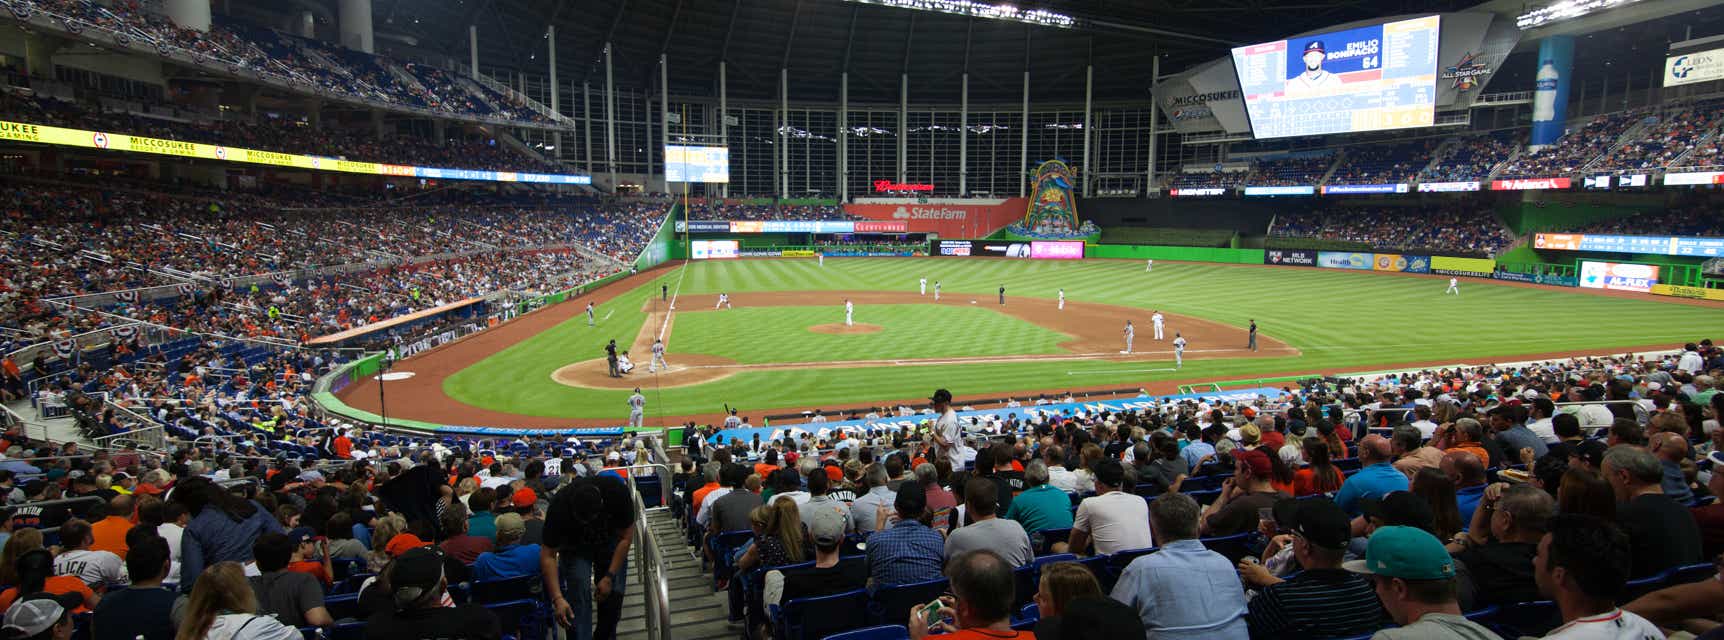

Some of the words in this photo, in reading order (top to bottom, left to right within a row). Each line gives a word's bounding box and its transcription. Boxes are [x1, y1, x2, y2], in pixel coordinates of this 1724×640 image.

[1346, 40, 1379, 51] EMILIO
[1327, 46, 1379, 60] BONIFACIO
[1174, 89, 1240, 105] MICCOSUKEE
[0, 122, 38, 135] UKEE
[130, 137, 195, 151] MICCOSUKEE
[247, 151, 292, 161] MICCOSUKEE
[1178, 187, 1226, 196] MONSTER
[1283, 257, 1313, 265] NETWORK
[548, 464, 560, 475] 21
[828, 490, 857, 502] TANTON
